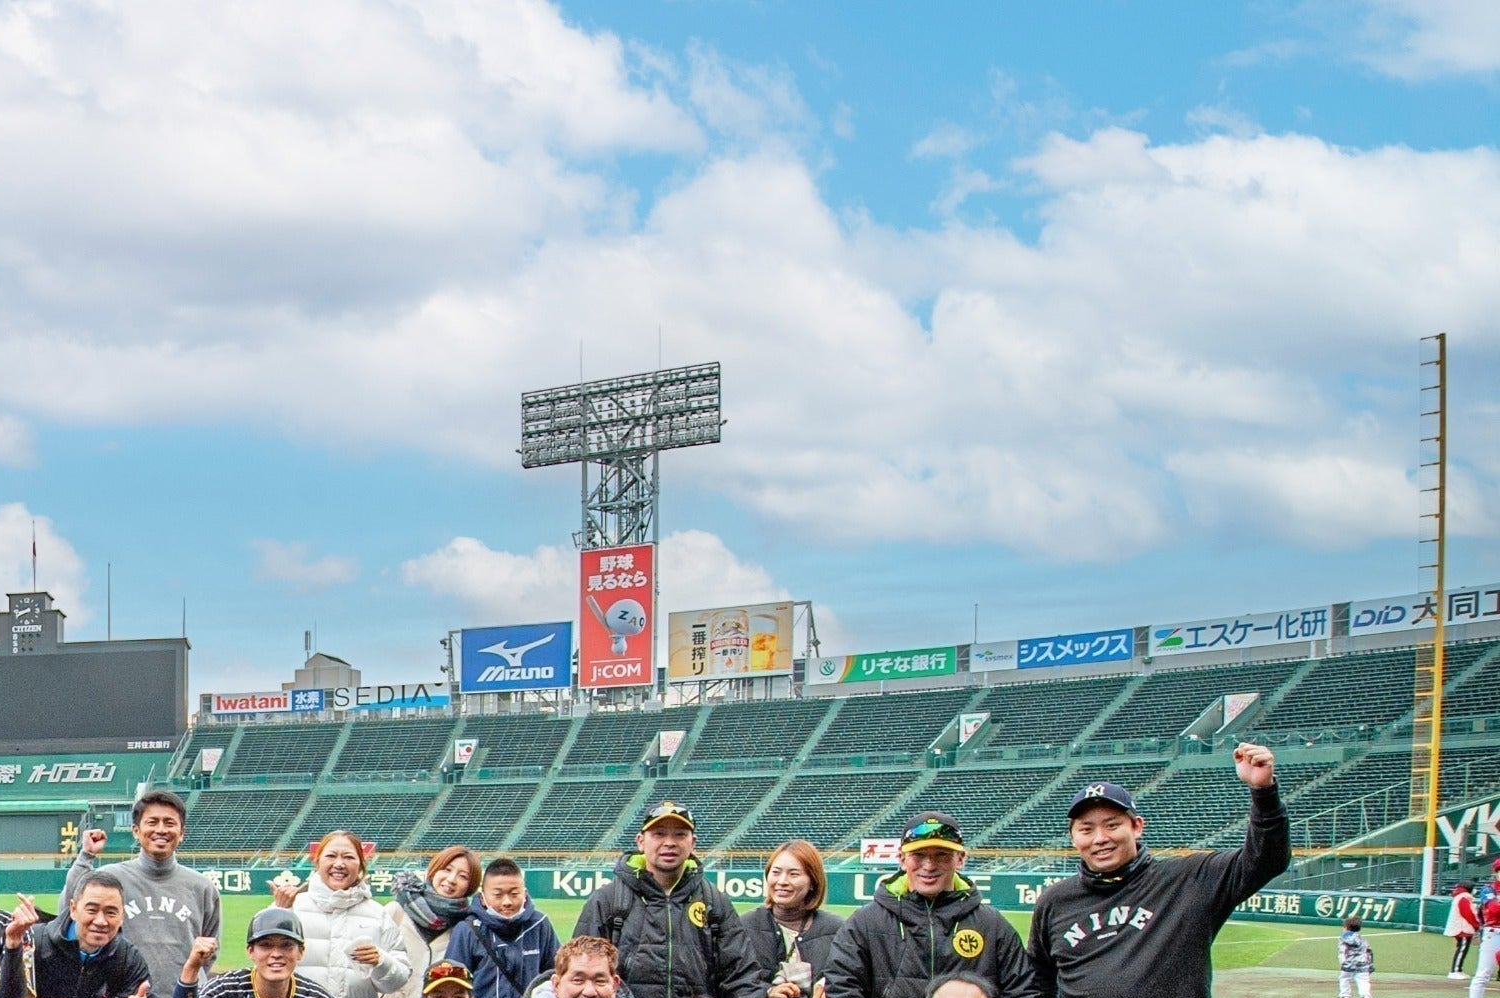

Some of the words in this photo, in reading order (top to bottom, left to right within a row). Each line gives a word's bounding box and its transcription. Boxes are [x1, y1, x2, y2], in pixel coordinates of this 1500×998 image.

[600, 553, 634, 573] 野球
[587, 571, 648, 592] 見るなら
[11, 625, 42, 633] CITIZEN
[1185, 608, 1328, 649] エスケー化研
[692, 623, 707, 676] 一番搾り
[985, 654, 1013, 662] sysmex
[1020, 633, 1129, 663] シスメックス
[590, 663, 642, 682] J:COM
[862, 652, 947, 676] りそな銀行
[216, 695, 288, 711] Iwatani
[294, 689, 320, 704] 水素
[127, 740, 170, 749] 三井住友銀行
[124, 897, 193, 923] NINE
[1336, 898, 1398, 921] リンテック
[1063, 905, 1154, 949] NINE
